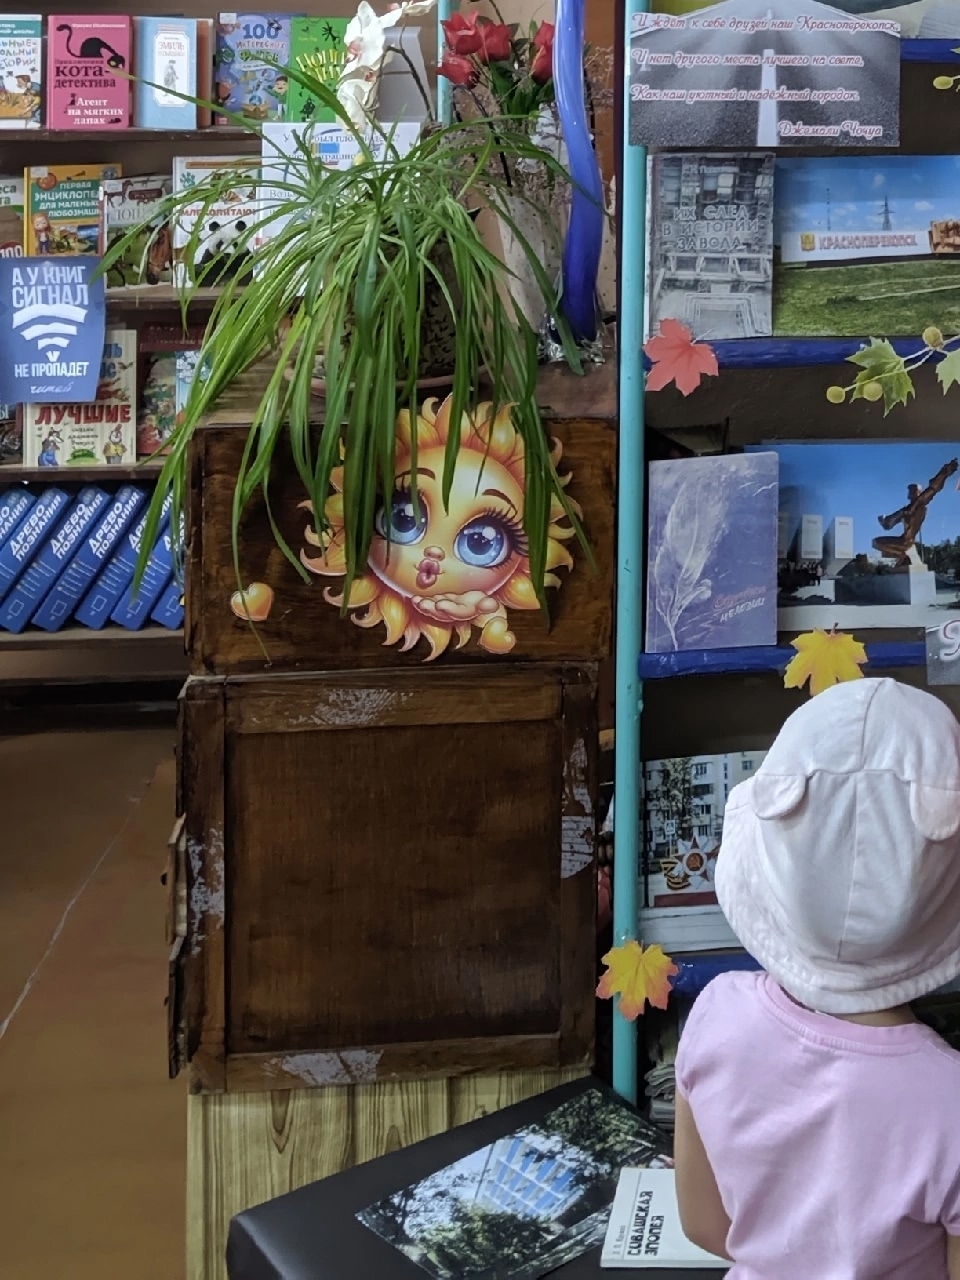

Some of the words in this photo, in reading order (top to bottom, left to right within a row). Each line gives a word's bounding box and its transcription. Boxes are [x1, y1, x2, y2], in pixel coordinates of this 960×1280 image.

[243, 23, 279, 40] 100
[632, 13, 646, 27] И
[691, 20, 700, 28] к
[702, 17, 727, 28] себе
[729, 17, 769, 31] друзей
[771, 20, 794, 30] наш
[796, 15, 900, 32] Красноперекопск,
[632, 48, 647, 63] И
[649, 54, 671, 64] нет
[674, 51, 720, 68] другого
[722, 54, 760, 64] места
[761, 55, 810, 68] лучшего
[812, 56, 825, 64] на
[827, 55, 865, 66] свете,
[55, 65, 110, 77] кота-
[54, 77, 116, 89] детектива
[77, 97, 108, 107] Агент
[630, 85, 659, 101] Как
[661, 90, 685, 101] наш
[686, 89, 738, 104] уютный
[738, 91, 748, 101] и
[812, 88, 860, 104] городок.
[67, 108, 81, 116] на
[82, 108, 123, 116] мягких
[73, 116, 106, 125] лапах
[778, 122, 840, 138] Джемали
[840, 121, 884, 141] Чочуа
[60, 181, 91, 190] ПЕРВАЯ
[39, 201, 57, 210] ДЛЯ
[673, 207, 697, 221] ИХ
[703, 204, 750, 220] СЛЕД
[662, 223, 672, 237] В
[681, 219, 760, 237] ИСТОРИИ
[676, 235, 742, 251] ЗАВОДА
[818, 234, 919, 251] КРАСНОПЕРЕКОПСК
[12, 267, 24, 286] А
[28, 266, 39, 284] У
[44, 265, 86, 284] КНИГ
[12, 284, 90, 308] СИГНАЛ
[14, 363, 29, 378] НЕ
[31, 361, 90, 377] ПРОПАДЕТ
[30, 380, 75, 395] читай
[35, 404, 132, 425] ЛУЧШИЕ
[10, 504, 45, 556] ДРЕВО
[15, 494, 62, 562] ПОЗНАНИЯ
[50, 503, 86, 555] ДРЕВО
[55, 493, 103, 560] ПОЗНАНИЯ
[88, 502, 123, 555] ДРЕВО
[95, 491, 140, 559] ПОЗНАНИЯ
[627, 1190, 653, 1258] СИВАШСКАЯ
[643, 1215, 665, 1257] ЭПОПЕЯ
